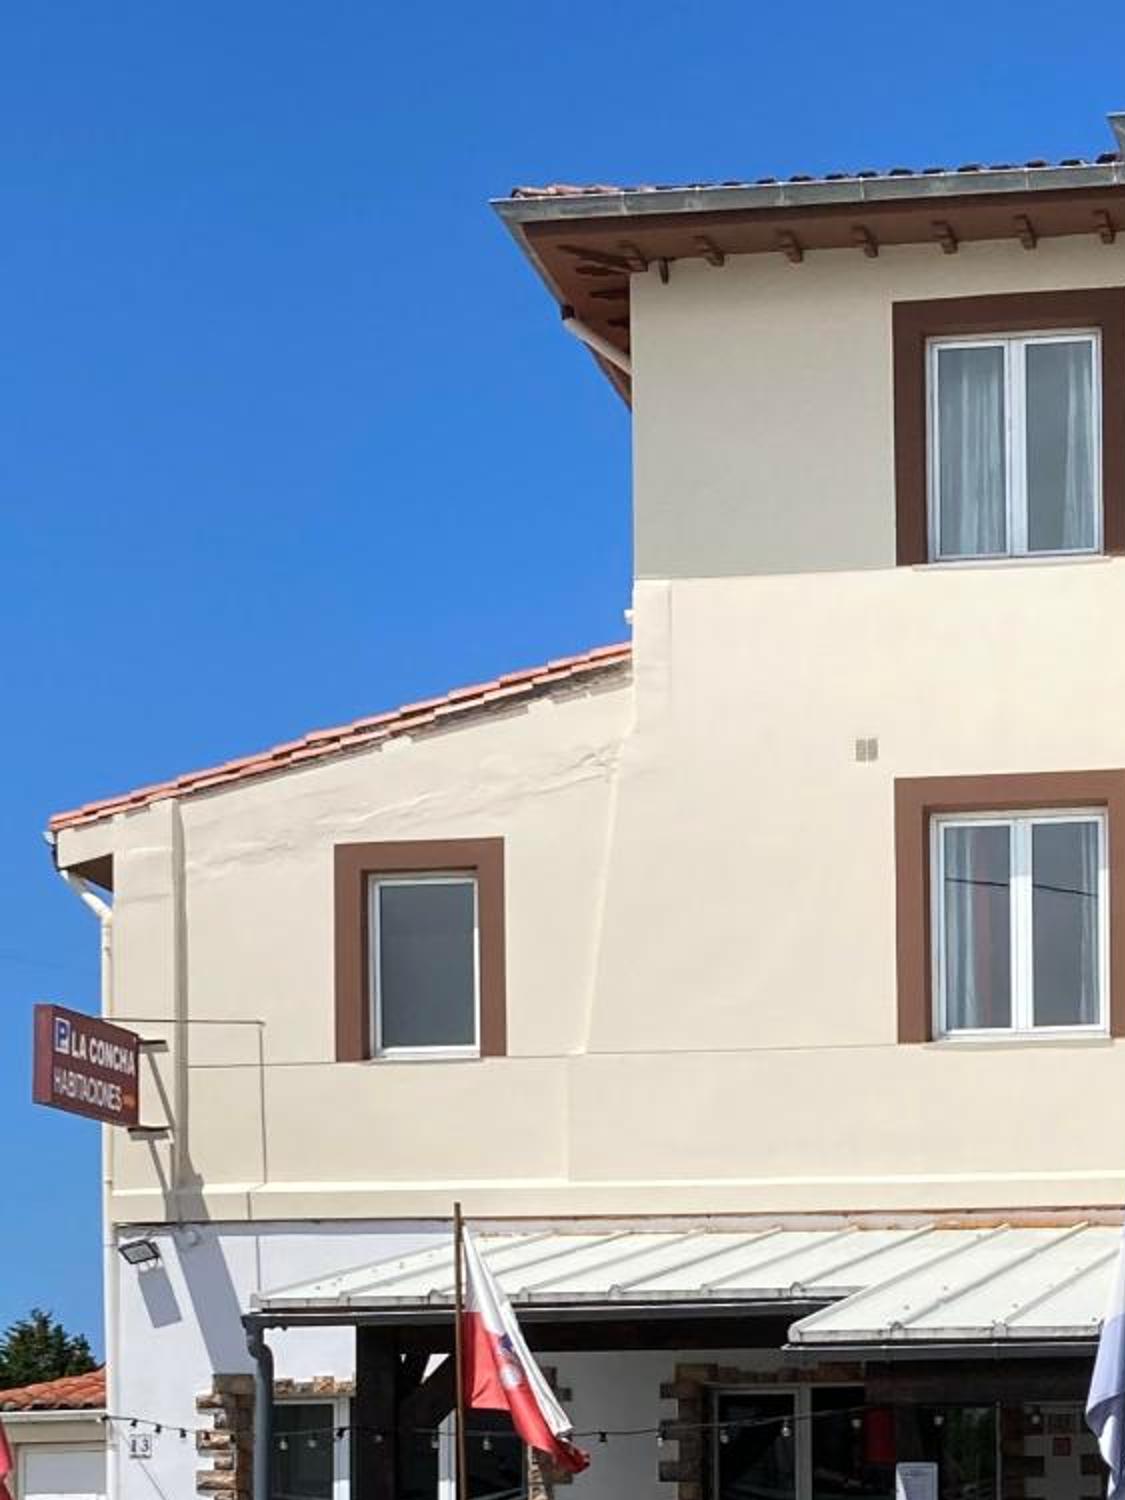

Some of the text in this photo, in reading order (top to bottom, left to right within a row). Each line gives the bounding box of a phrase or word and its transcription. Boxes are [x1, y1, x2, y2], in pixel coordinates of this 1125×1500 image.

[72, 1031, 87, 1060] LA
[89, 1037, 135, 1078] CONCHA
[53, 1065, 121, 1112] HABITACIONES
[131, 1439, 149, 1452] 13
